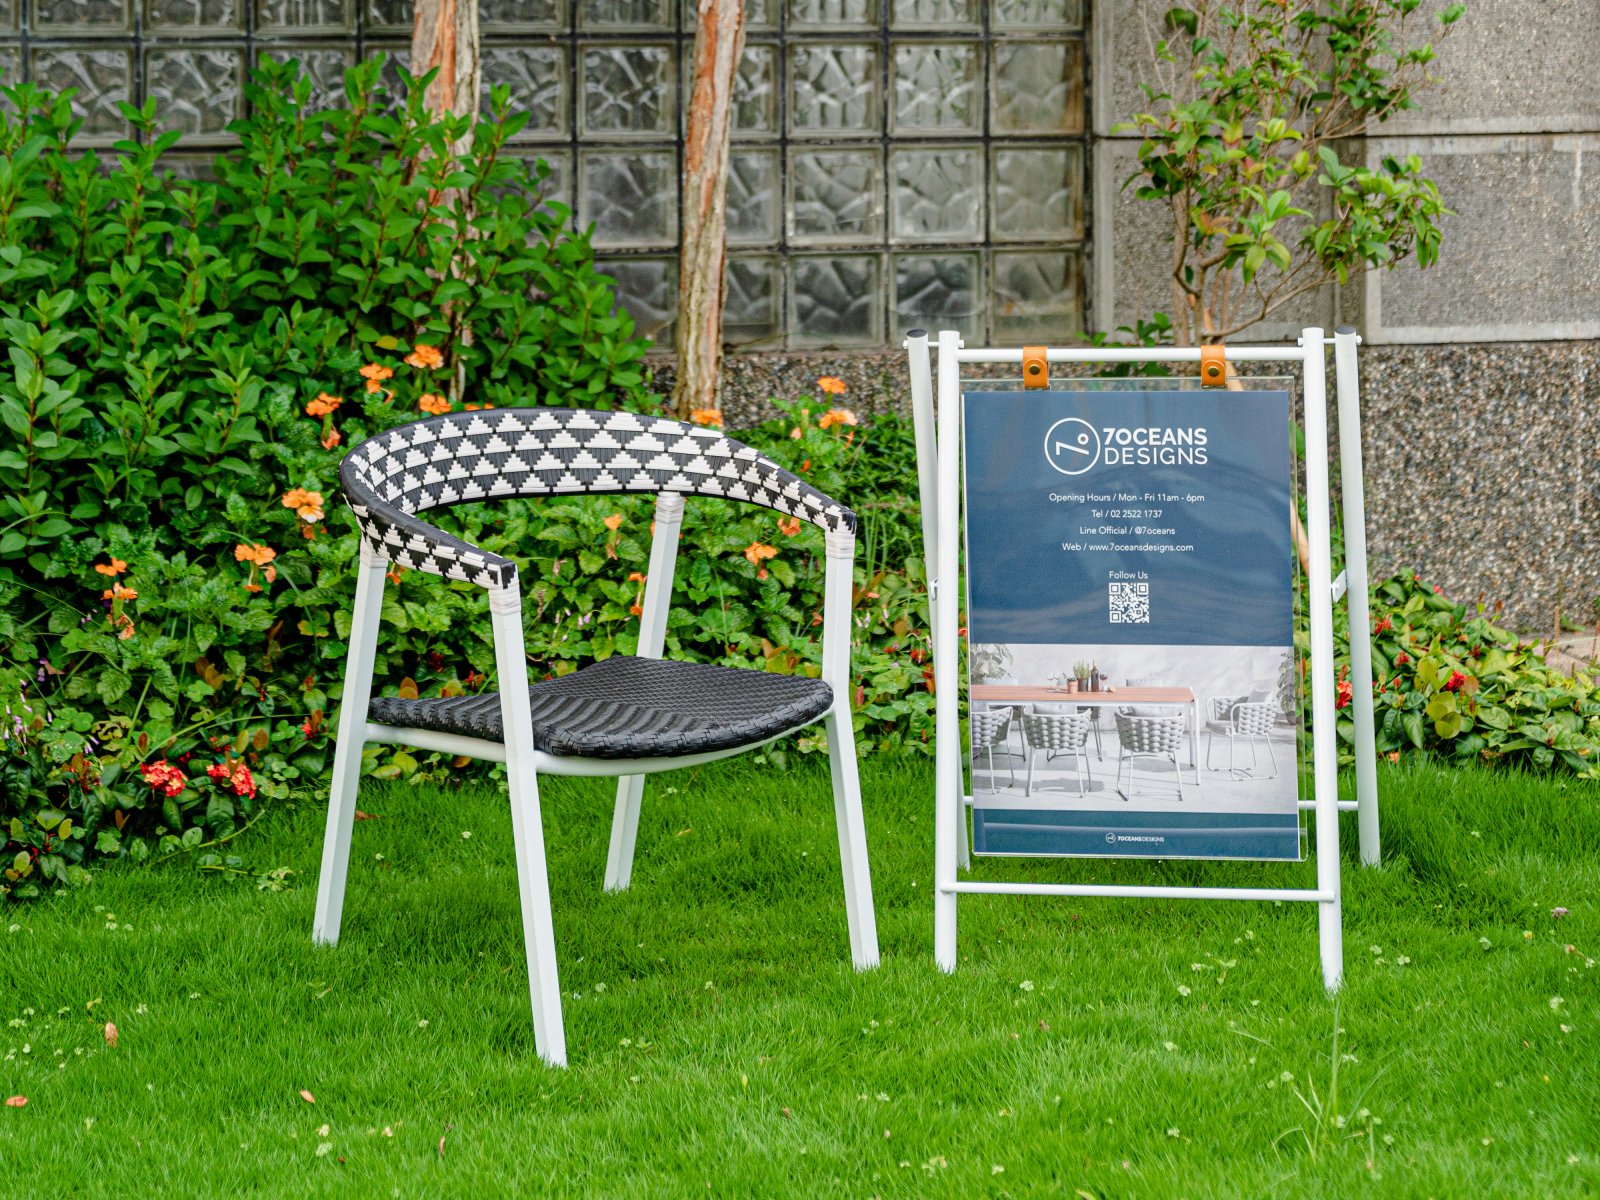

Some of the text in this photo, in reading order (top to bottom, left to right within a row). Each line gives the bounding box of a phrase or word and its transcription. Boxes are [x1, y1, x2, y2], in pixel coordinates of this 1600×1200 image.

[1104, 447, 1208, 465] DESIGNS
[1048, 492, 1085, 503] Opening
[1086, 493, 1111, 502] Hours
[1118, 493, 1138, 502] Mon
[1144, 493, 1155, 502] Fri
[1157, 493, 1180, 502] 11am
[1186, 493, 1205, 504] 6pm
[1091, 509, 1103, 518] Tel
[1110, 509, 1121, 518] 02
[1122, 509, 1142, 518] 2522
[1144, 509, 1163, 518] 1737
[1079, 526, 1097, 535] Line
[1098, 525, 1128, 535] Official
[1134, 526, 1176, 535] @7oceans
[1061, 542, 1082, 551] Web
[1088, 542, 1194, 554] www.7oceansdesigns.com
[1108, 570, 1149, 580] Follow Us
